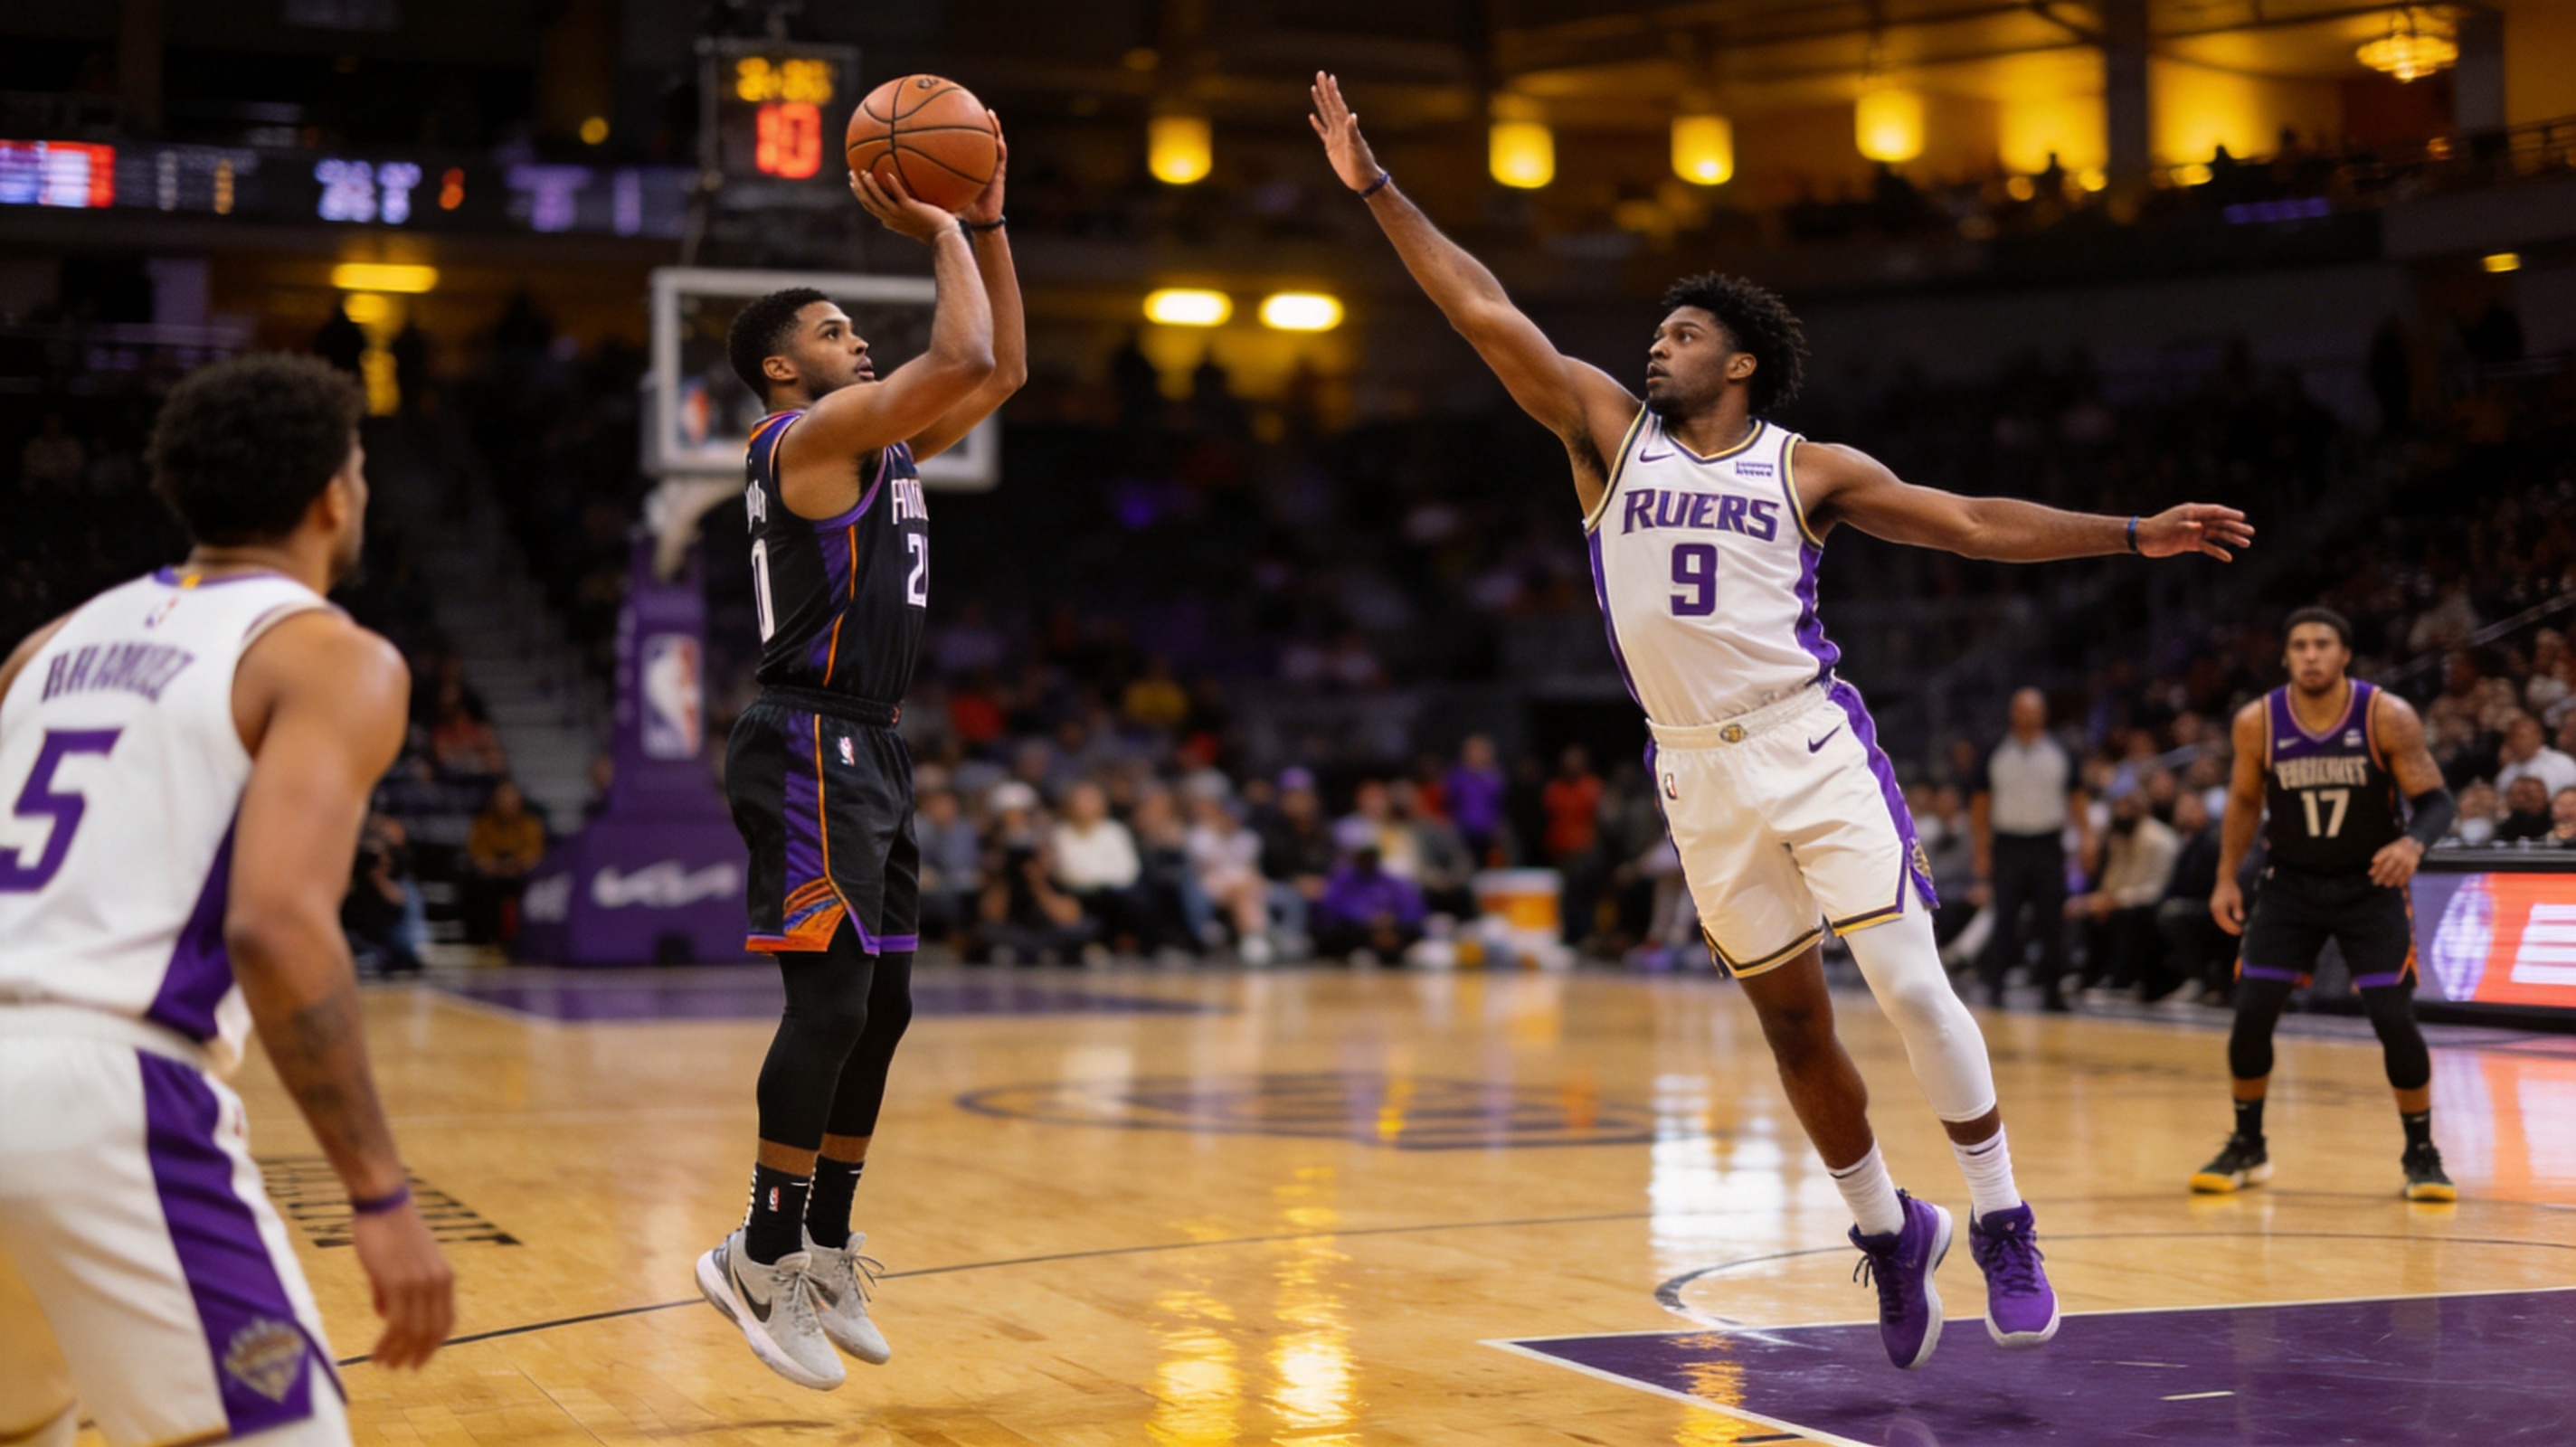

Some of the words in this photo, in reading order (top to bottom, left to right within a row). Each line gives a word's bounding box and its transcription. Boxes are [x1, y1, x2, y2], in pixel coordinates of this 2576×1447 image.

[907, 534, 929, 608] 2
[1671, 544, 1717, 615] 9
[0, 728, 124, 893] 5
[2300, 789, 2350, 837] 17
